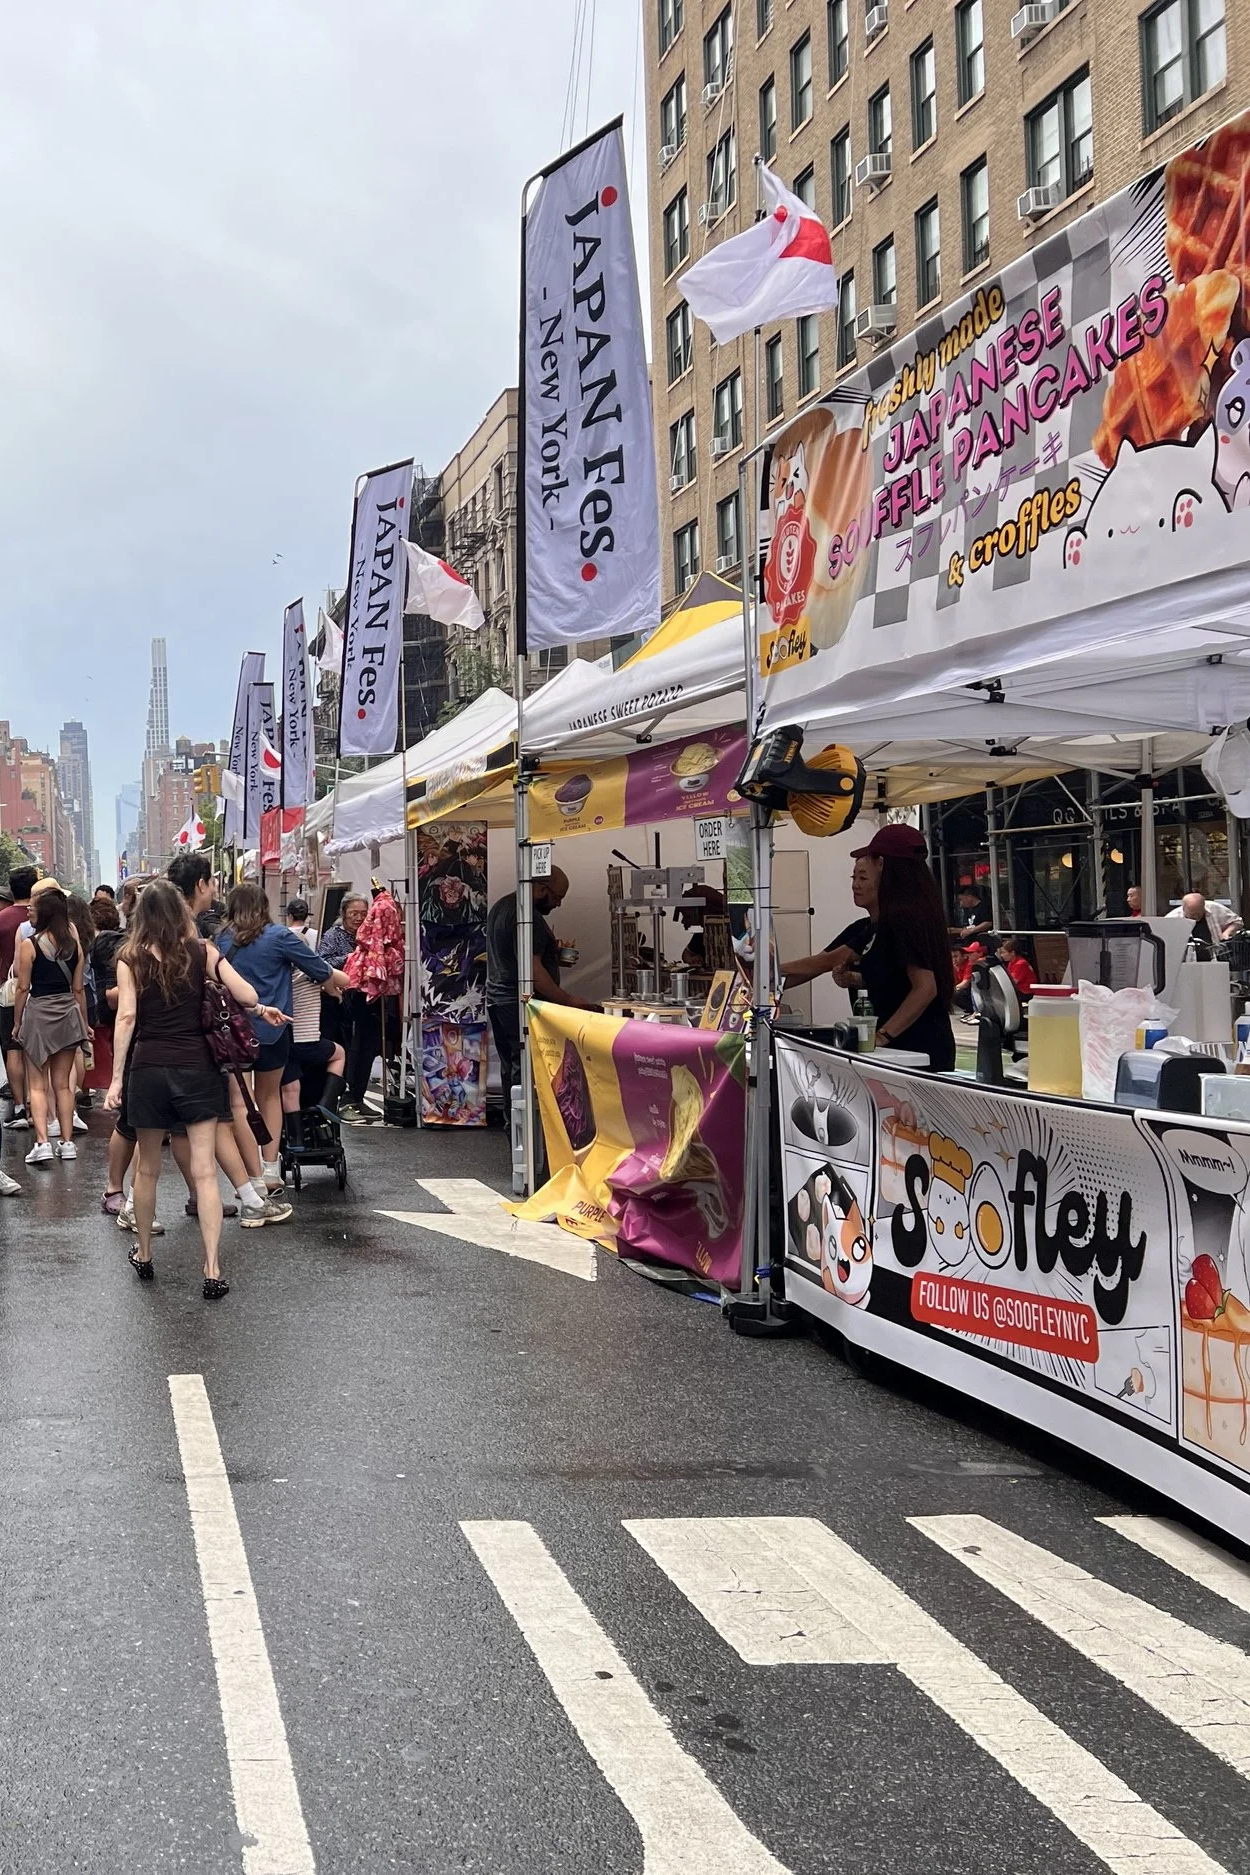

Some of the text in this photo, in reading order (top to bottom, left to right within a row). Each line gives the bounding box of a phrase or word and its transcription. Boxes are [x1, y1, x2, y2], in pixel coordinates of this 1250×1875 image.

[538, 308, 564, 402] New
[565, 185, 627, 581] JAPAN Fes.
[861, 284, 1006, 453] freshly made
[882, 285, 1065, 475] JAPANESE
[540, 406, 571, 509] York
[828, 274, 1169, 582] SOUFFLE PANCAKES
[948, 476, 1083, 588] & croffles
[345, 558, 368, 671] New York
[356, 497, 406, 720] JAPAN Fes.
[234, 726, 243, 750] New
[288, 668, 300, 747] New York
[611, 698, 639, 720] SWEET
[641, 684, 683, 710] POTATO
[250, 731, 259, 791] New York
[681, 791, 709, 800] YELLOW
[688, 800, 715, 809] CREAM
[699, 821, 722, 838] ORDER
[536, 862, 546, 873] HERE
[703, 840, 720, 856] HERE
[572, 1201, 607, 1223] PURPLE
[919, 1280, 1091, 1345] FOLLOW US @SOOFLEYNYC
